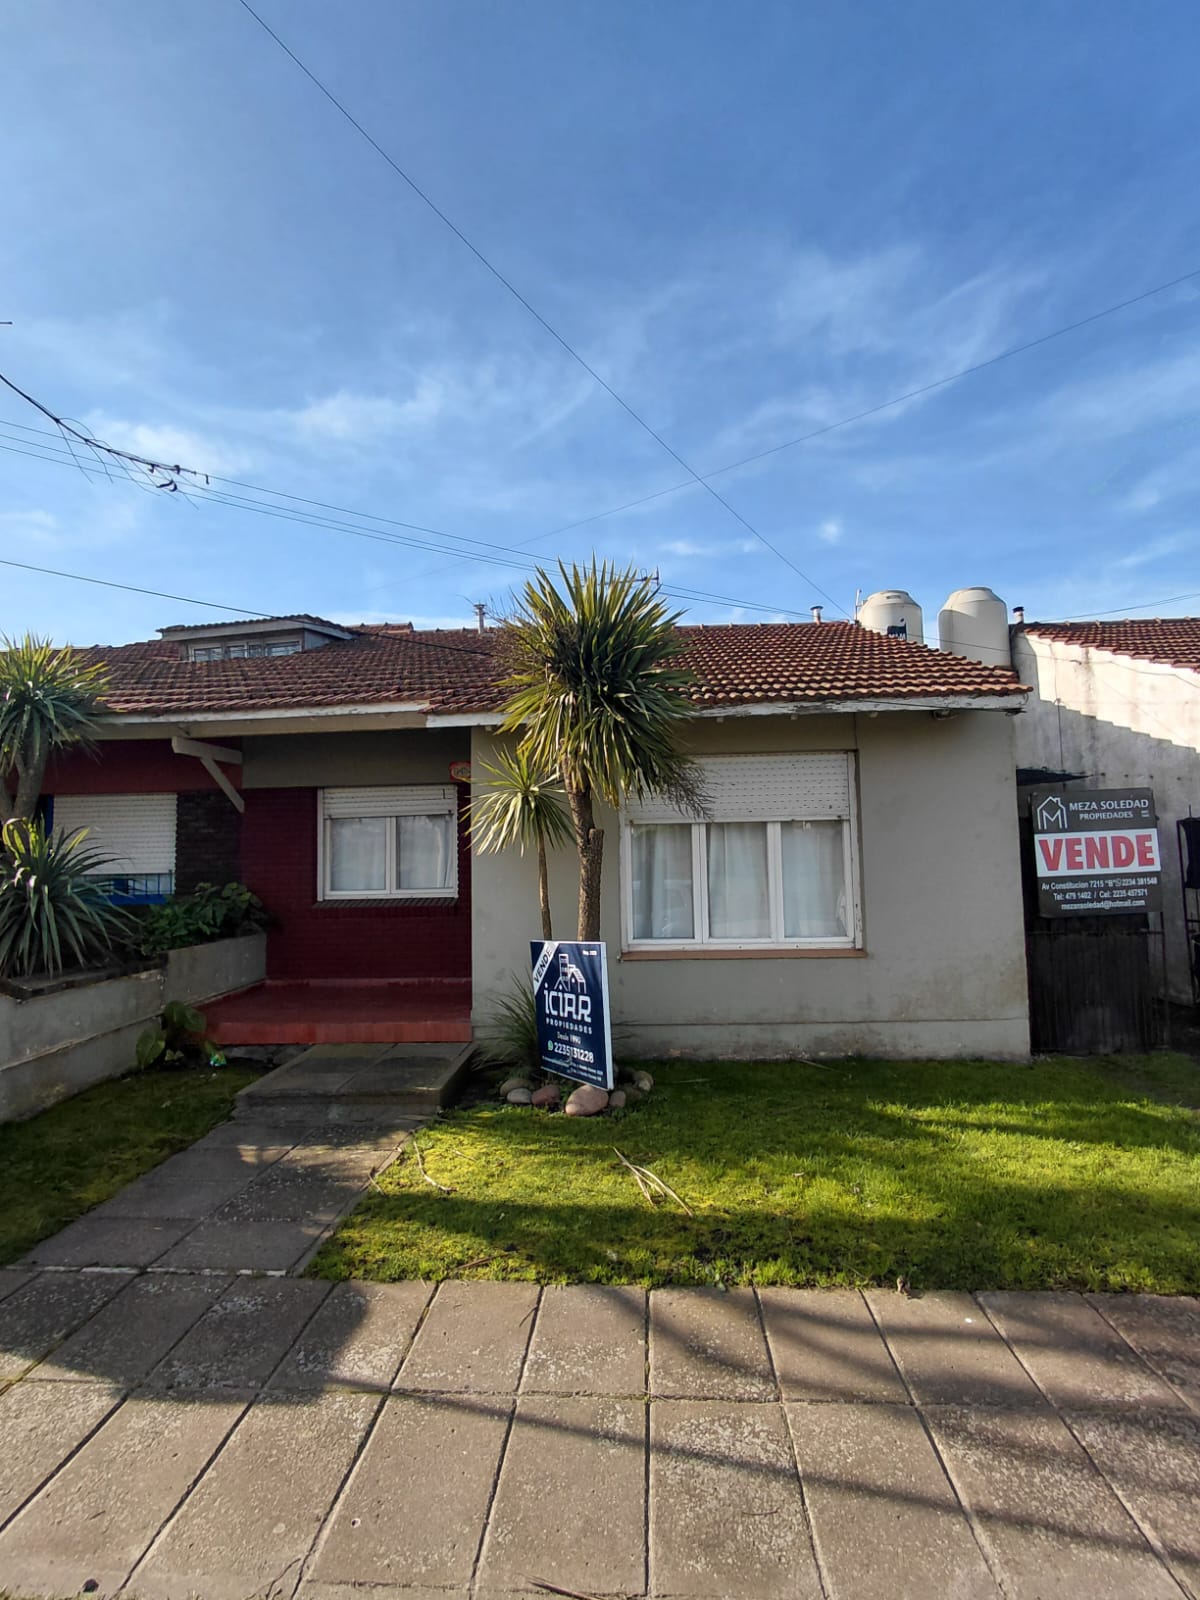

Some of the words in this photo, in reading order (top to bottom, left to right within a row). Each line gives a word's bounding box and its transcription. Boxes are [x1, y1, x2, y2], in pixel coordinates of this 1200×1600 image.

[1069, 801, 1098, 811] MEZA
[1100, 799, 1149, 810] SOLEDAD
[1079, 810, 1134, 820] PROPIEDADES
[1038, 834, 1155, 871] VENDE
[534, 947, 552, 983] VENDE
[545, 1017, 593, 1035] PROPIEDADES
